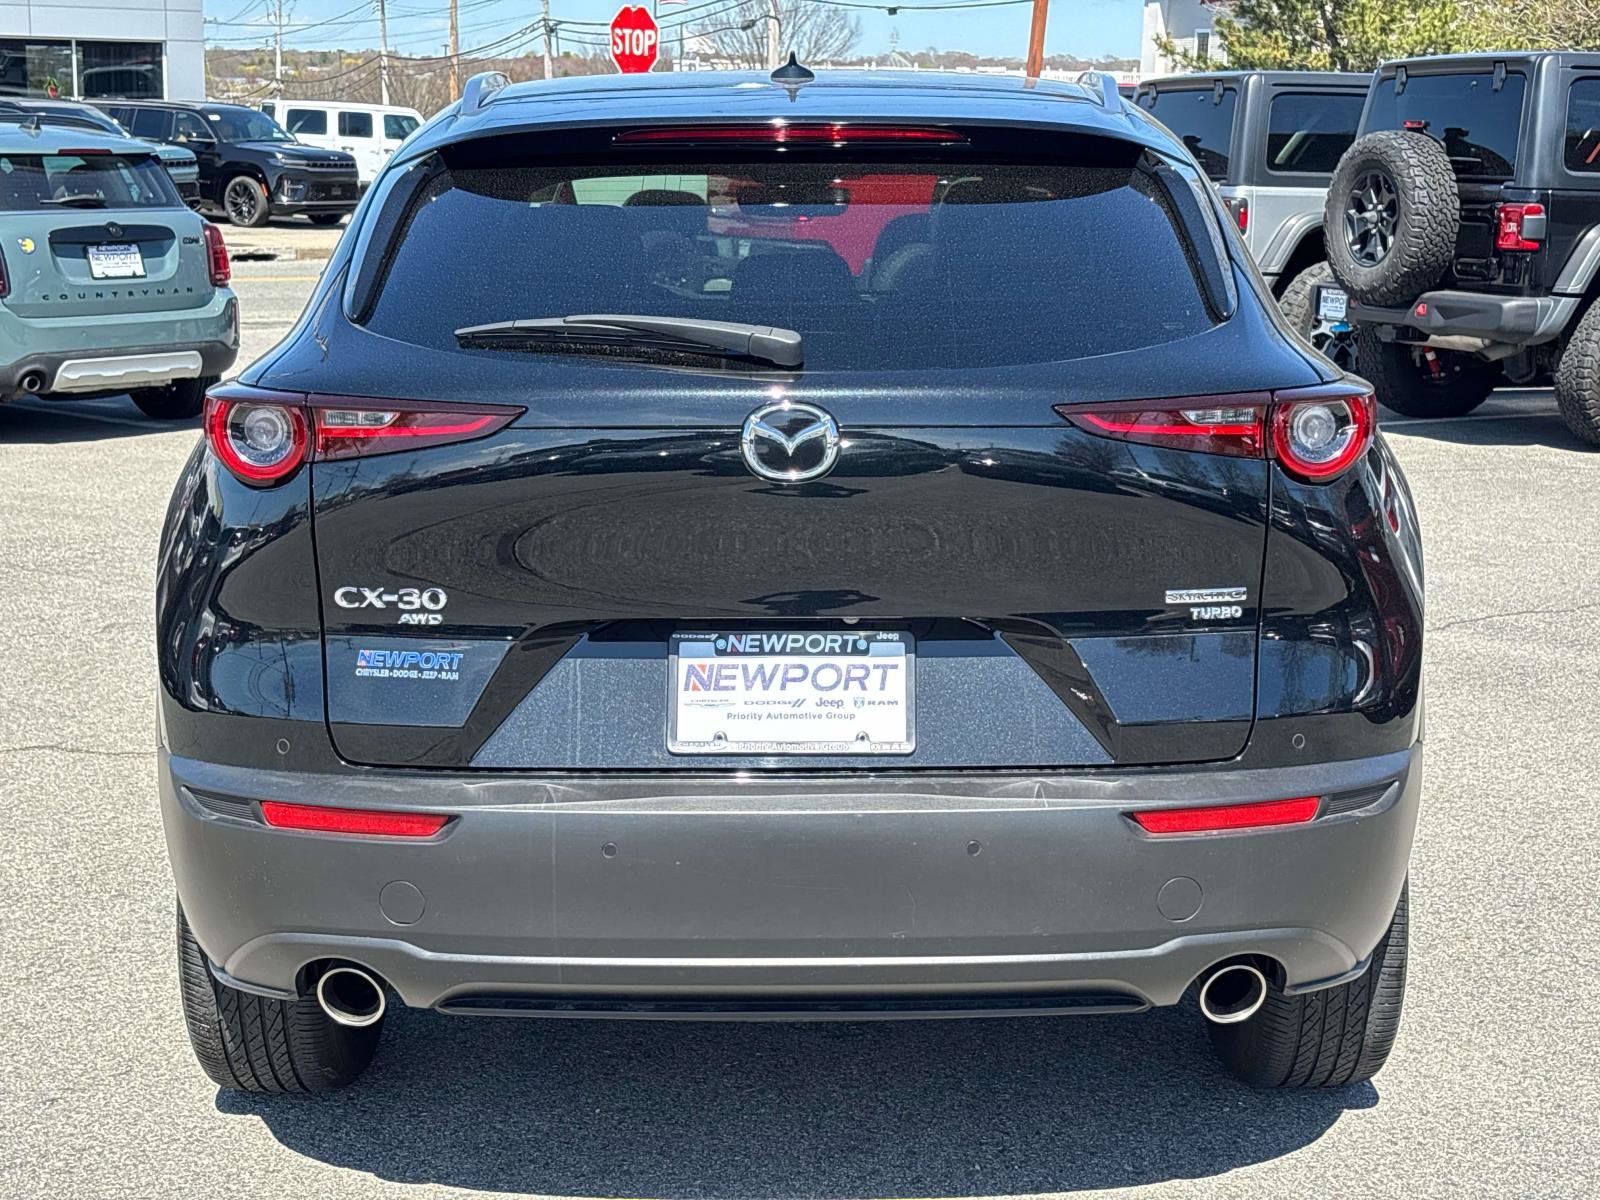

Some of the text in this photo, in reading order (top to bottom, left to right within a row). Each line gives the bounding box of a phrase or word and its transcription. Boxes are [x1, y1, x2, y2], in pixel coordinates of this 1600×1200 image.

[613, 27, 656, 57] STOP
[91, 252, 137, 261] NEWPORT
[42, 286, 193, 301] COUNTRYMAN
[1322, 295, 1345, 305] NEWPO
[334, 587, 448, 611] CX-30
[397, 613, 443, 625] AWD
[1190, 605, 1242, 620] TURBO
[727, 634, 859, 653] NEWPORT
[876, 631, 900, 641] Jeep
[357, 649, 463, 669] NEWPORT
[683, 663, 899, 692] NEWPORT
[815, 697, 844, 709] Jeep
[727, 711, 856, 721] Priority Automotive Group
